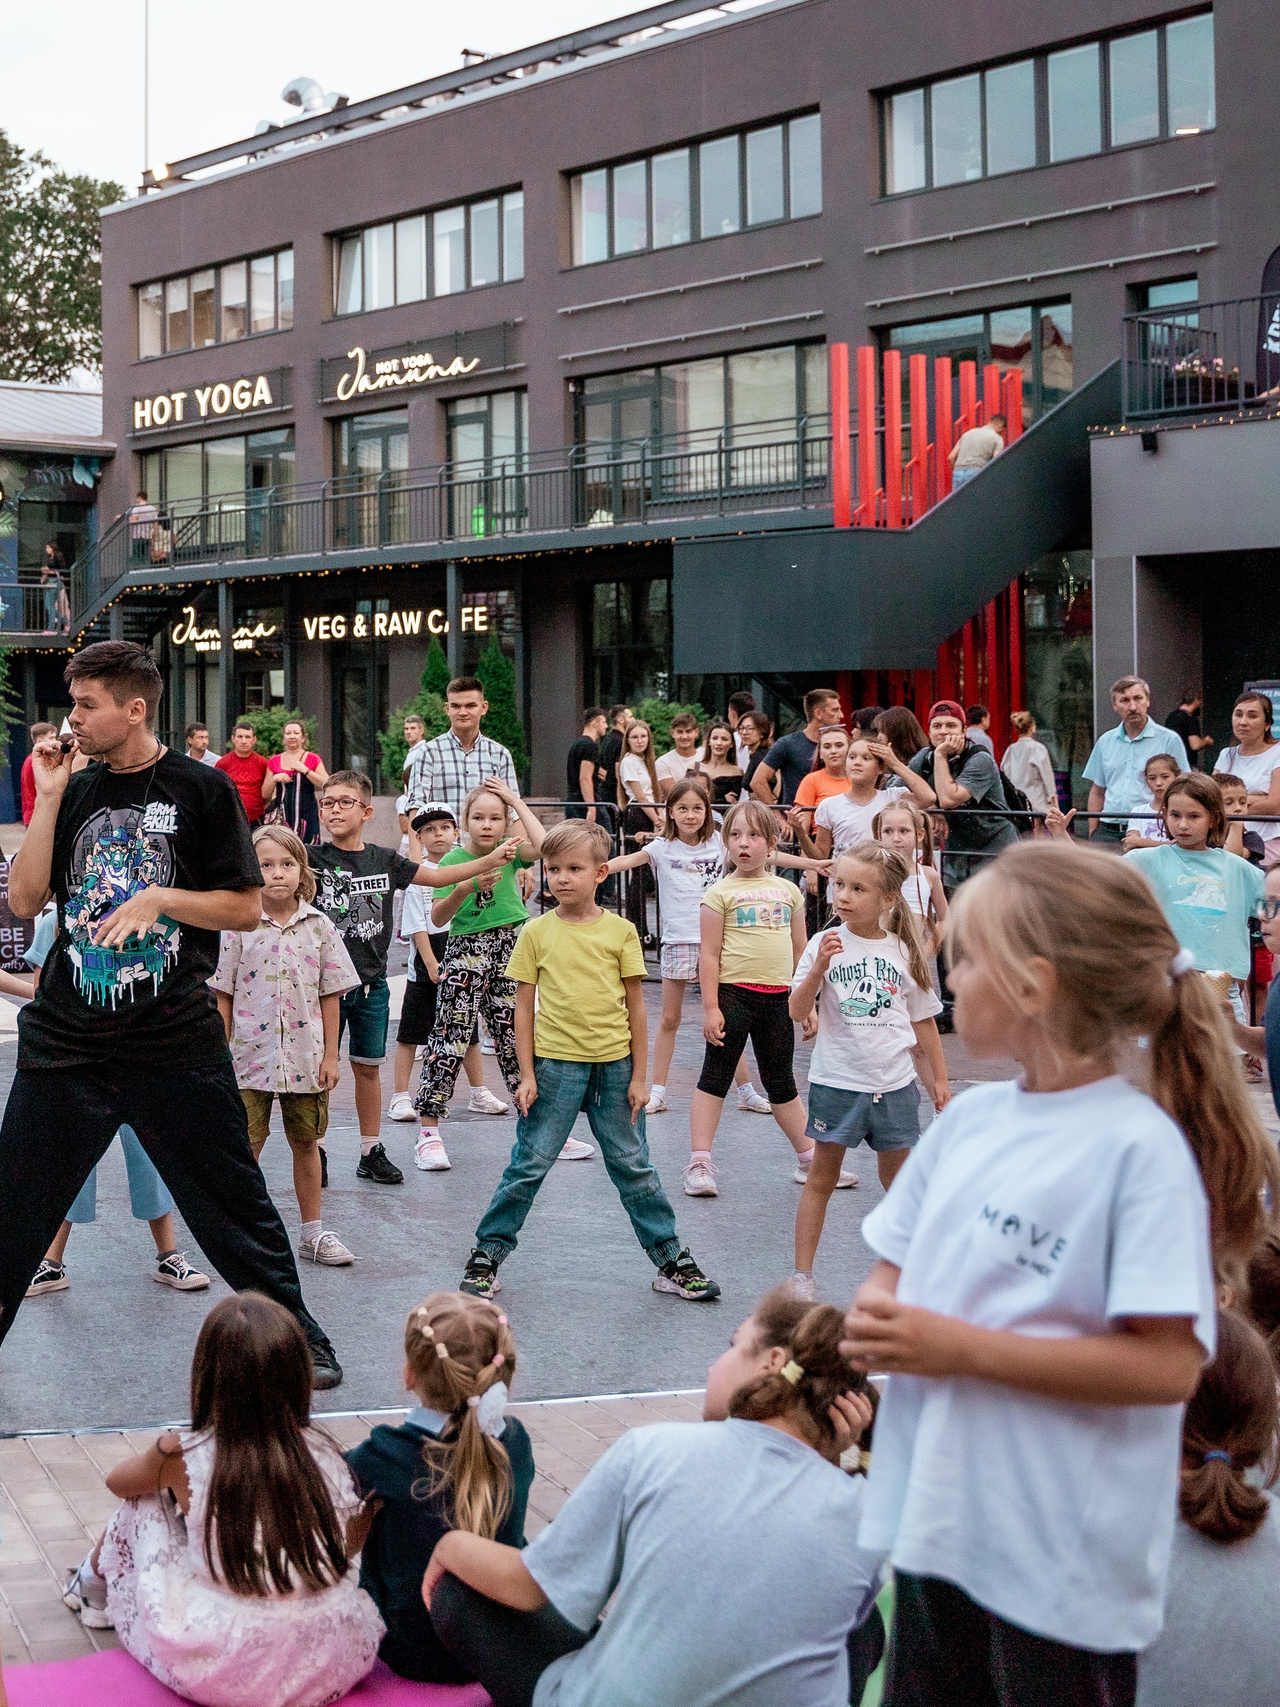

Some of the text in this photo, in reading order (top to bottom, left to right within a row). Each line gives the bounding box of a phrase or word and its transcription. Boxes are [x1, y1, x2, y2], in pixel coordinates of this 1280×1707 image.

[376, 352, 434, 374] HOT YOGA
[134, 375, 273, 429] HOT YOGA
[172, 606, 276, 645] Jamna
[303, 615, 347, 640] VEG
[353, 613, 367, 638] &
[374, 610, 422, 637] RAW
[351, 877, 387, 892] STREET
[829, 956, 867, 988] Ghost
